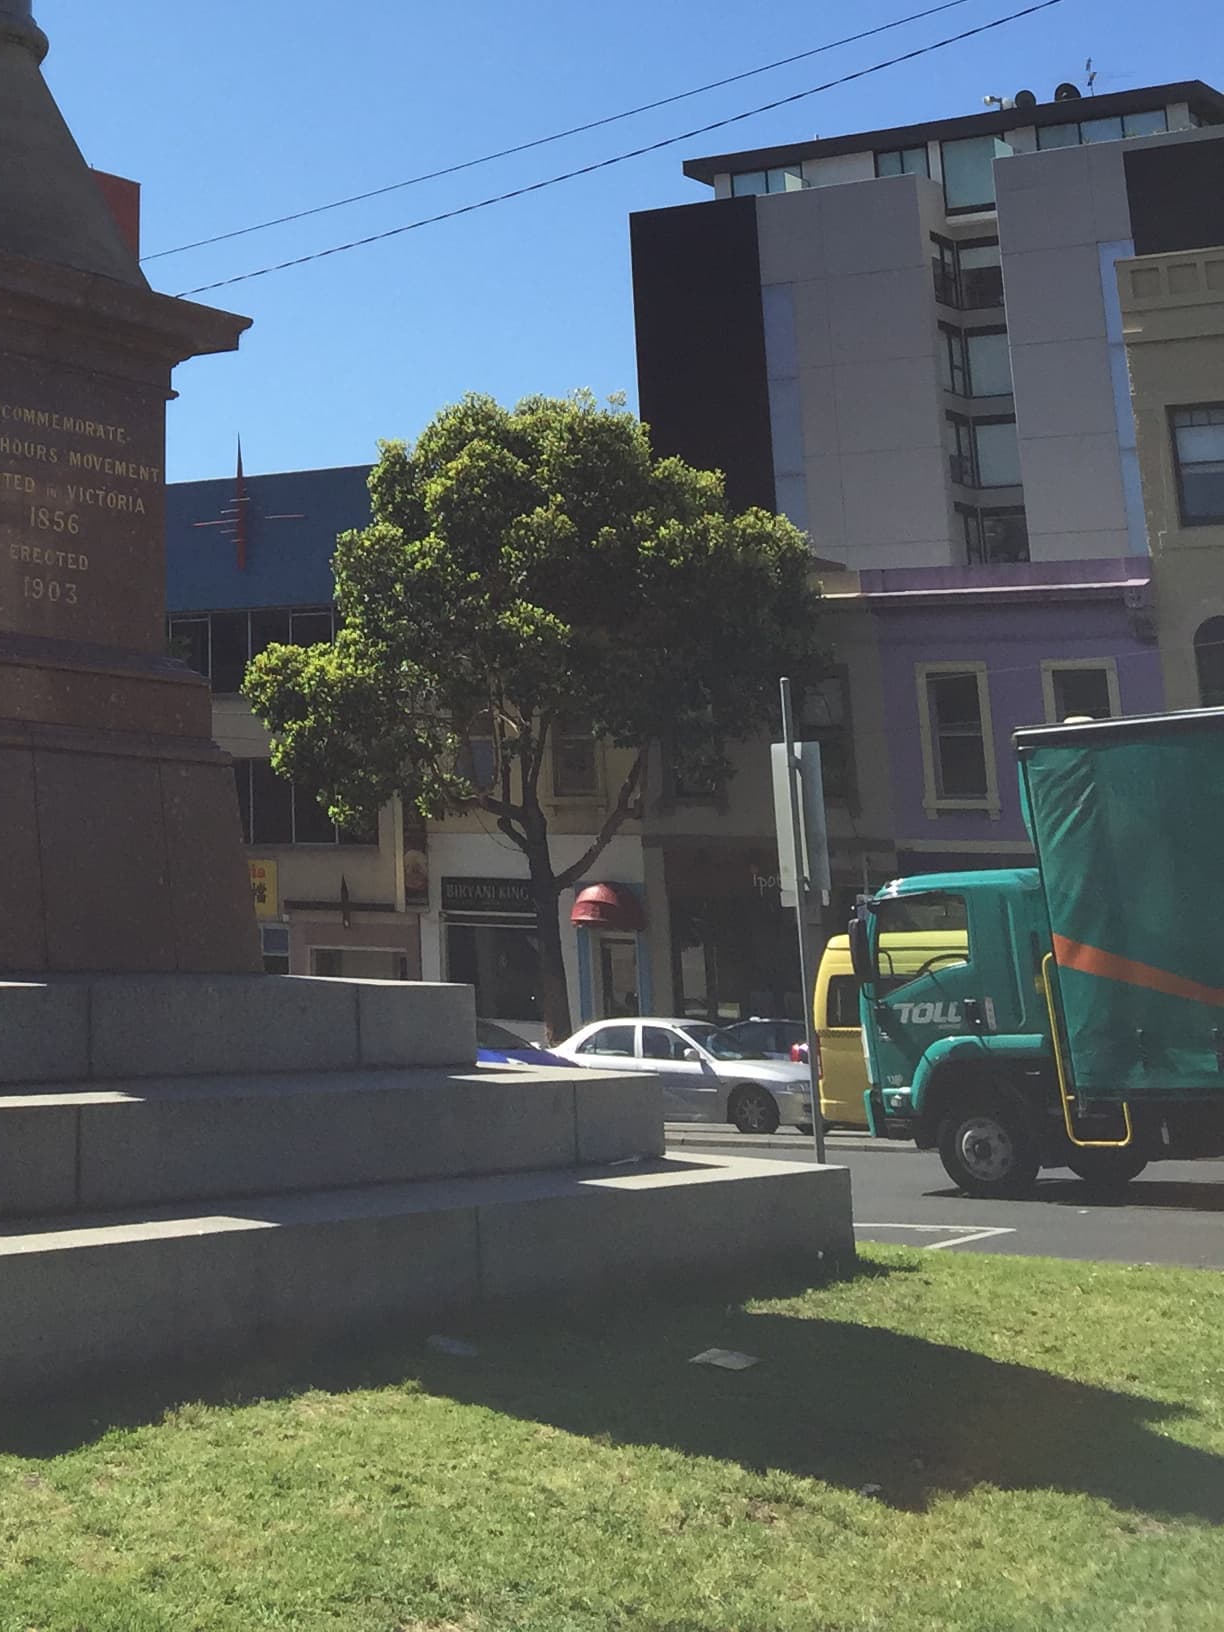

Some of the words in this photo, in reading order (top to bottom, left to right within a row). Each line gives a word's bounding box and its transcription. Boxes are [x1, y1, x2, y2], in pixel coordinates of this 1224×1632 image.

[1, 404, 126, 444] COMMEMORATE
[0, 435, 58, 464] HOURS
[68, 450, 161, 484] MOVEMENT
[67, 484, 146, 515] VICTORIA
[29, 505, 80, 535] 1856
[9, 543, 89, 571] ERECTED
[23, 576, 78, 605] 1903
[446, 884, 496, 899] BIRYANI
[499, 885, 529, 901] KING
[893, 1001, 962, 1024] TOLL
